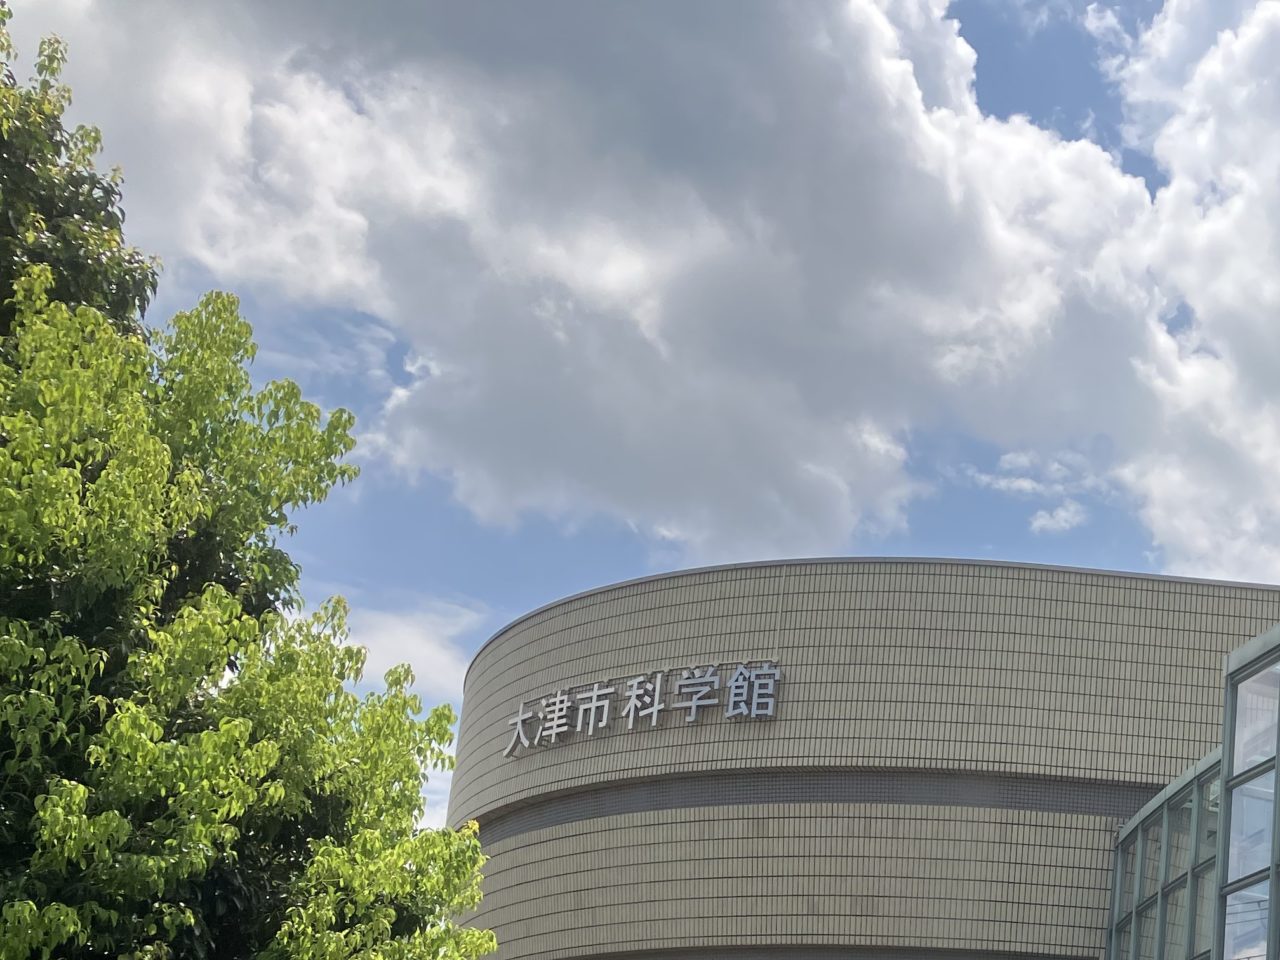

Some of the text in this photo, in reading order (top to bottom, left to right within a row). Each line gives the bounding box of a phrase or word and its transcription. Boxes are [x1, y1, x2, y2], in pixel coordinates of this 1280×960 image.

[502, 662, 782, 759] 大津市科学館
